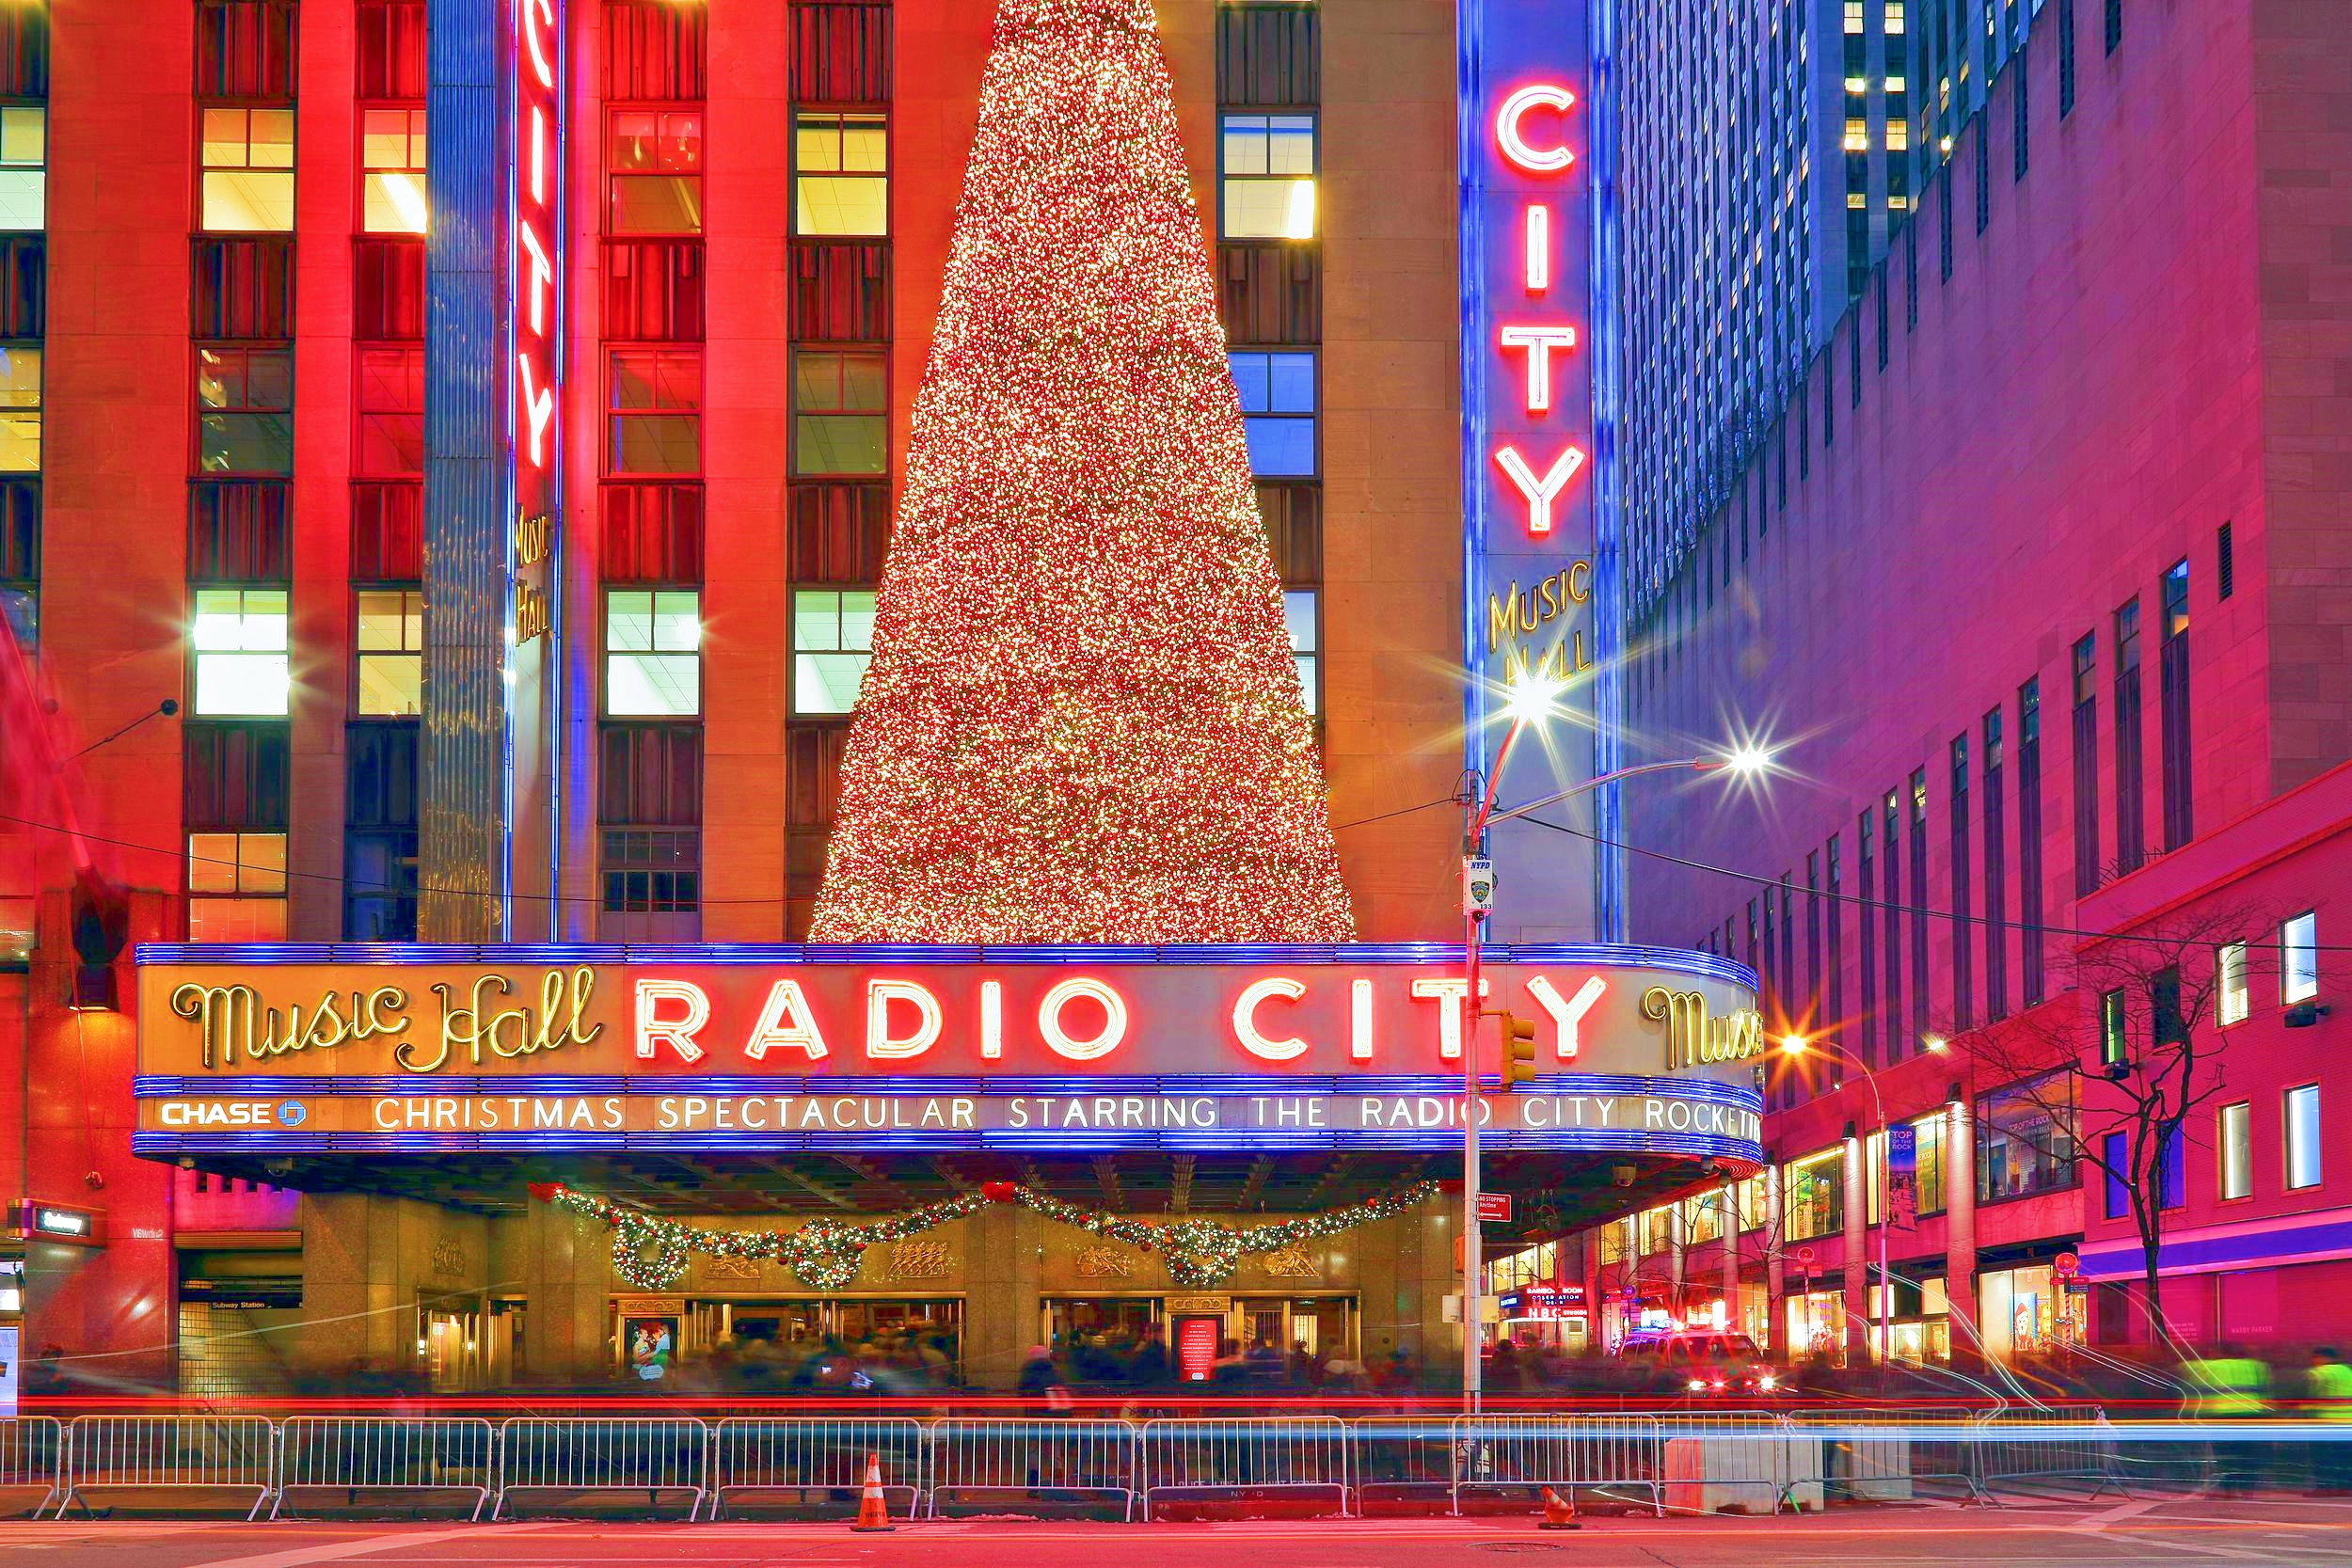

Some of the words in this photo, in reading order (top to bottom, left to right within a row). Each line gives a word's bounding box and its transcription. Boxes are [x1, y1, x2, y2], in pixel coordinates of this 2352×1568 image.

[1494, 83, 1586, 534] CITY
[516, 503, 549, 565] MUSIC
[516, 581, 549, 647] HALL
[1489, 560, 1591, 655] MUSIC
[171, 982, 407, 1069] Music
[394, 964, 604, 1074] Hall
[635, 976, 1129, 1065] RADIO
[1232, 974, 1608, 1062] CITY
[160, 1101, 273, 1127] CHASE
[374, 1097, 625, 1130] CHRISTMAS
[658, 1096, 977, 1129] SPECTACULAR
[1008, 1096, 1218, 1130] STARRING
[1250, 1096, 1327, 1128] THE
[1522, 1096, 1617, 1129] CITY
[1892, 1131, 1913, 1139] TOP
